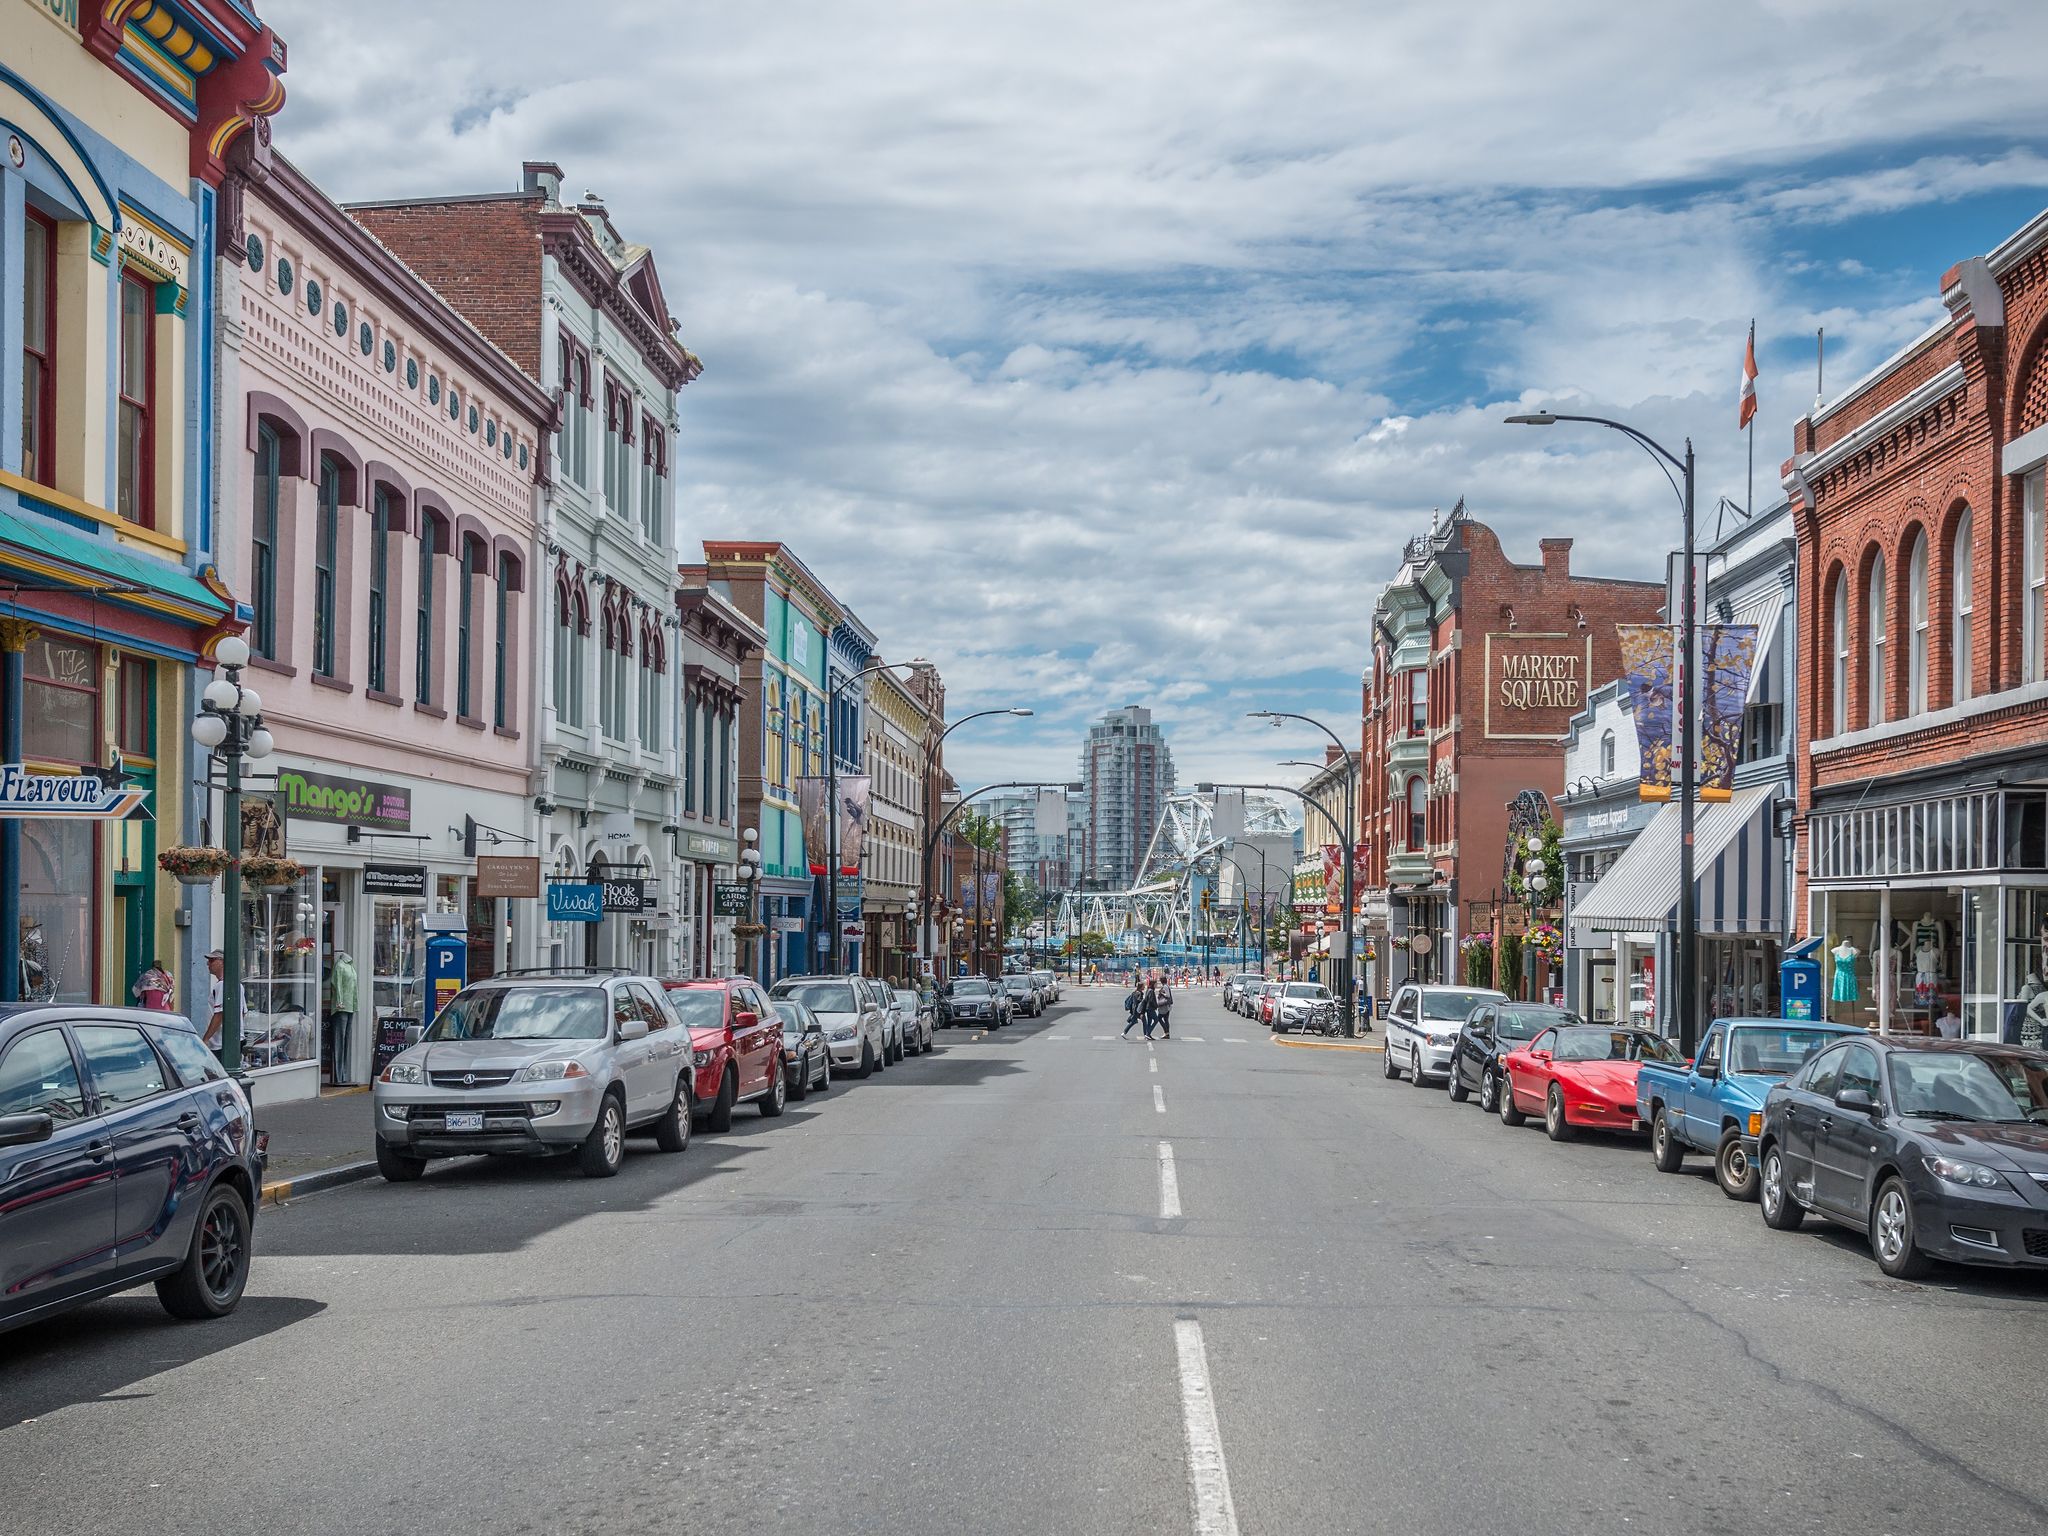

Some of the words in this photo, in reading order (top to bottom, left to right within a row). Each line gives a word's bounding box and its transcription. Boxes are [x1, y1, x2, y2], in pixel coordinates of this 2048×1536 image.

[1501, 655, 1579, 679] MARKET
[1500, 680, 1579, 711] SQUARE
[0, 767, 98, 804] FLAVOUR
[279, 773, 375, 818] Mango's
[382, 795, 405, 808] BOUTIQUE
[376, 808, 381, 817] &
[381, 808, 410, 820] ACCESSORIES
[1587, 810, 1609, 828] American
[1609, 804, 1628, 829] Apparel
[603, 882, 635, 897] Rook
[720, 892, 746, 900] CARDS
[551, 888, 599, 912] Vivah
[608, 894, 640, 907] Rose
[440, 951, 454, 969] P
[1793, 972, 1807, 990] P
[383, 1021, 394, 1029] BC
